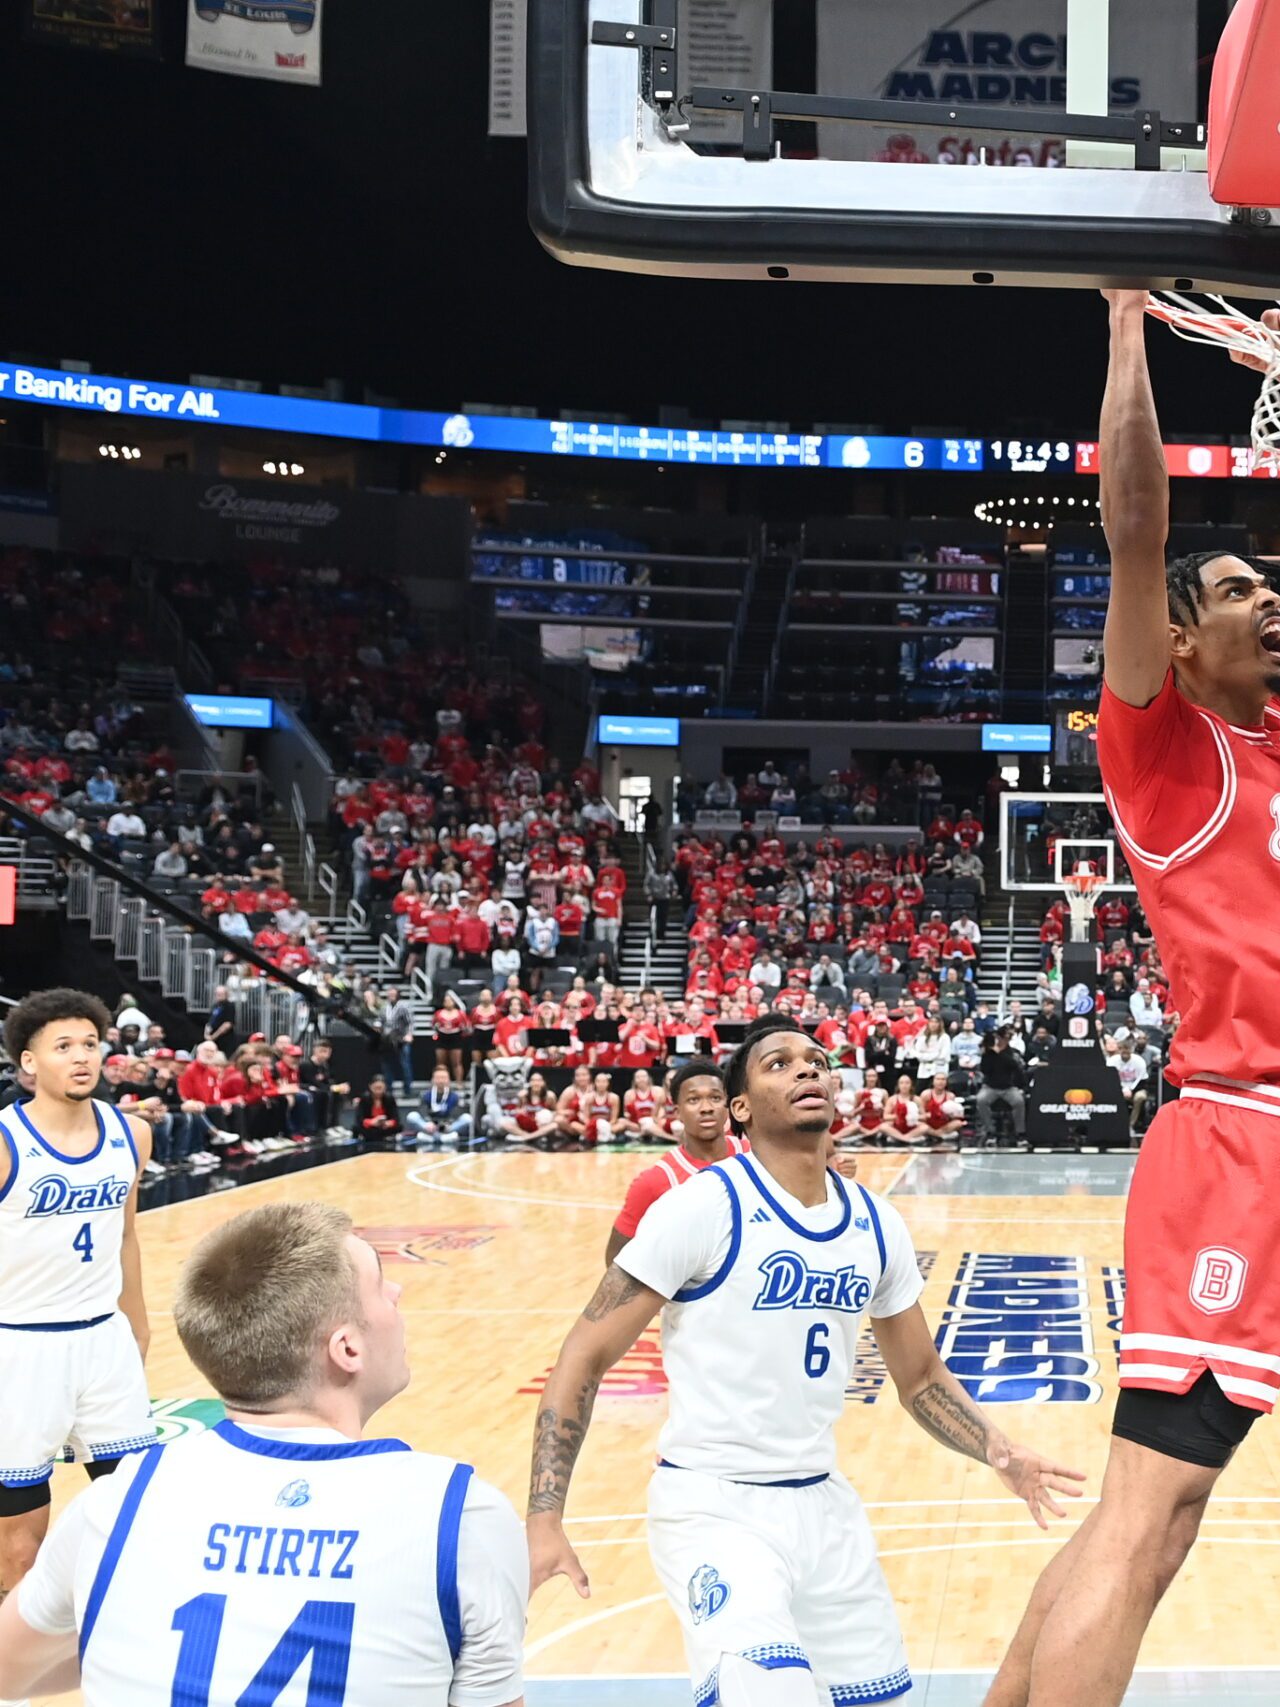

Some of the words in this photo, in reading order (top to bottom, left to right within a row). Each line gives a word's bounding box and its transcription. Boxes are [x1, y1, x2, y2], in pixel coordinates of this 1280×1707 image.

[880, 72, 1142, 106] MADNES
[14, 369, 122, 412] Banking
[128, 384, 175, 413] For
[178, 390, 220, 418] All.
[903, 441, 924, 468] 6
[990, 440, 1071, 463] 15:43
[234, 523, 301, 544] LOUNGE
[1061, 1039, 1095, 1048] BRADLEY
[1039, 1104, 1067, 1113] GREAT
[1070, 1104, 1118, 1113] SOUTHERN
[1065, 1113, 1091, 1121] BANK
[25, 1173, 129, 1218] Drake
[72, 1222, 94, 1263] 4
[752, 1250, 871, 1313] Drake
[804, 1322, 830, 1379] 6
[203, 1522, 360, 1579] STIRTZ
[170, 1592, 356, 1707] 14
